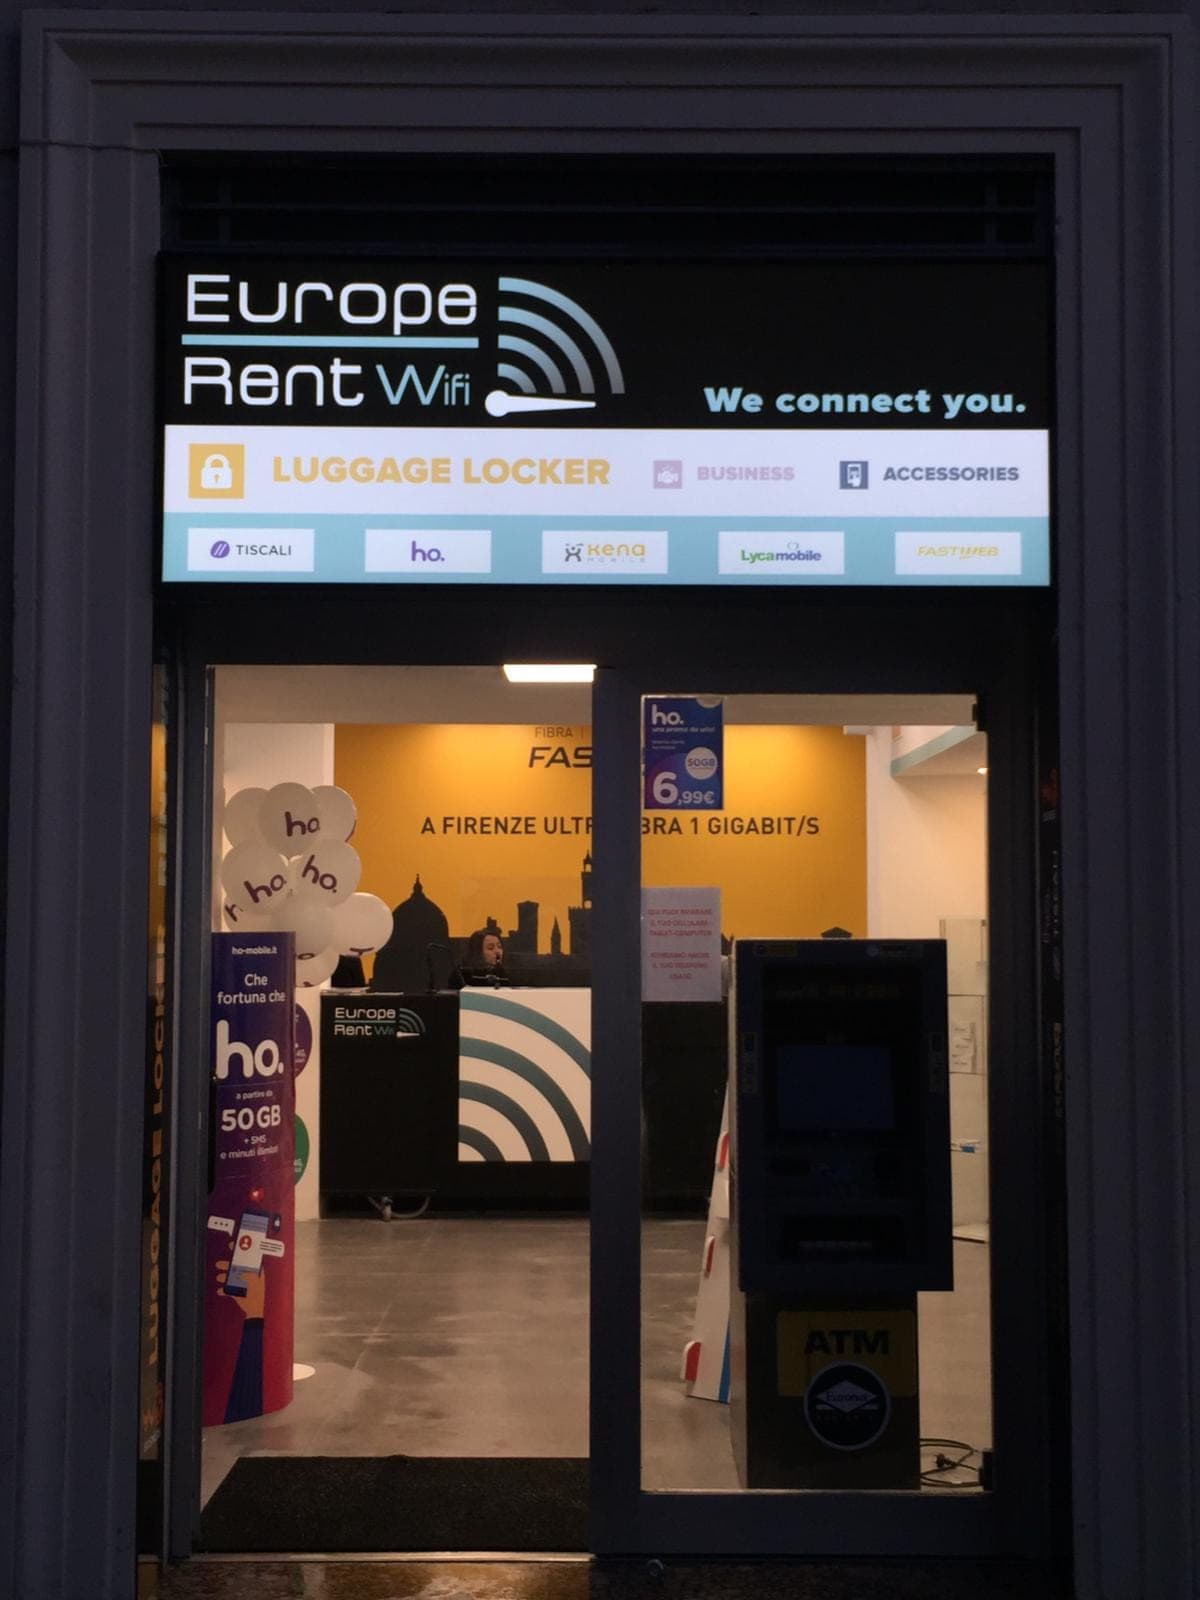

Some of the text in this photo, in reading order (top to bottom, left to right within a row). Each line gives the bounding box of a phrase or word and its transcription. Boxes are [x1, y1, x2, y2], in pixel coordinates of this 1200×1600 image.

[186, 273, 477, 336] Europe
[184, 356, 470, 406] Rent Wifi
[704, 387, 1027, 419] We connect you.
[273, 456, 611, 485] LUGGAGE LOCKER
[697, 466, 795, 481] BUSINESS
[883, 466, 1020, 482] ACCESSORIES
[236, 544, 292, 556] TISCALI
[411, 540, 445, 563] ho.
[741, 549, 822, 564] Lycamobile
[651, 703, 684, 726] ho.
[535, 726, 573, 738] FIBRA
[652, 770, 716, 806] 6,99€
[420, 816, 436, 835] A
[442, 816, 537, 835] FIRENZE
[690, 816, 699, 835] 1
[708, 815, 820, 837] GIGABIT/S
[244, 973, 269, 987] Che
[217, 990, 286, 1005] fortuna che
[335, 1007, 396, 1020] Europe
[334, 1024, 373, 1036] Rent
[216, 1019, 284, 1079] ho.
[220, 1152, 227, 1160] e
[228, 1147, 256, 1160] minuti
[804, 1329, 890, 1355] ATM
